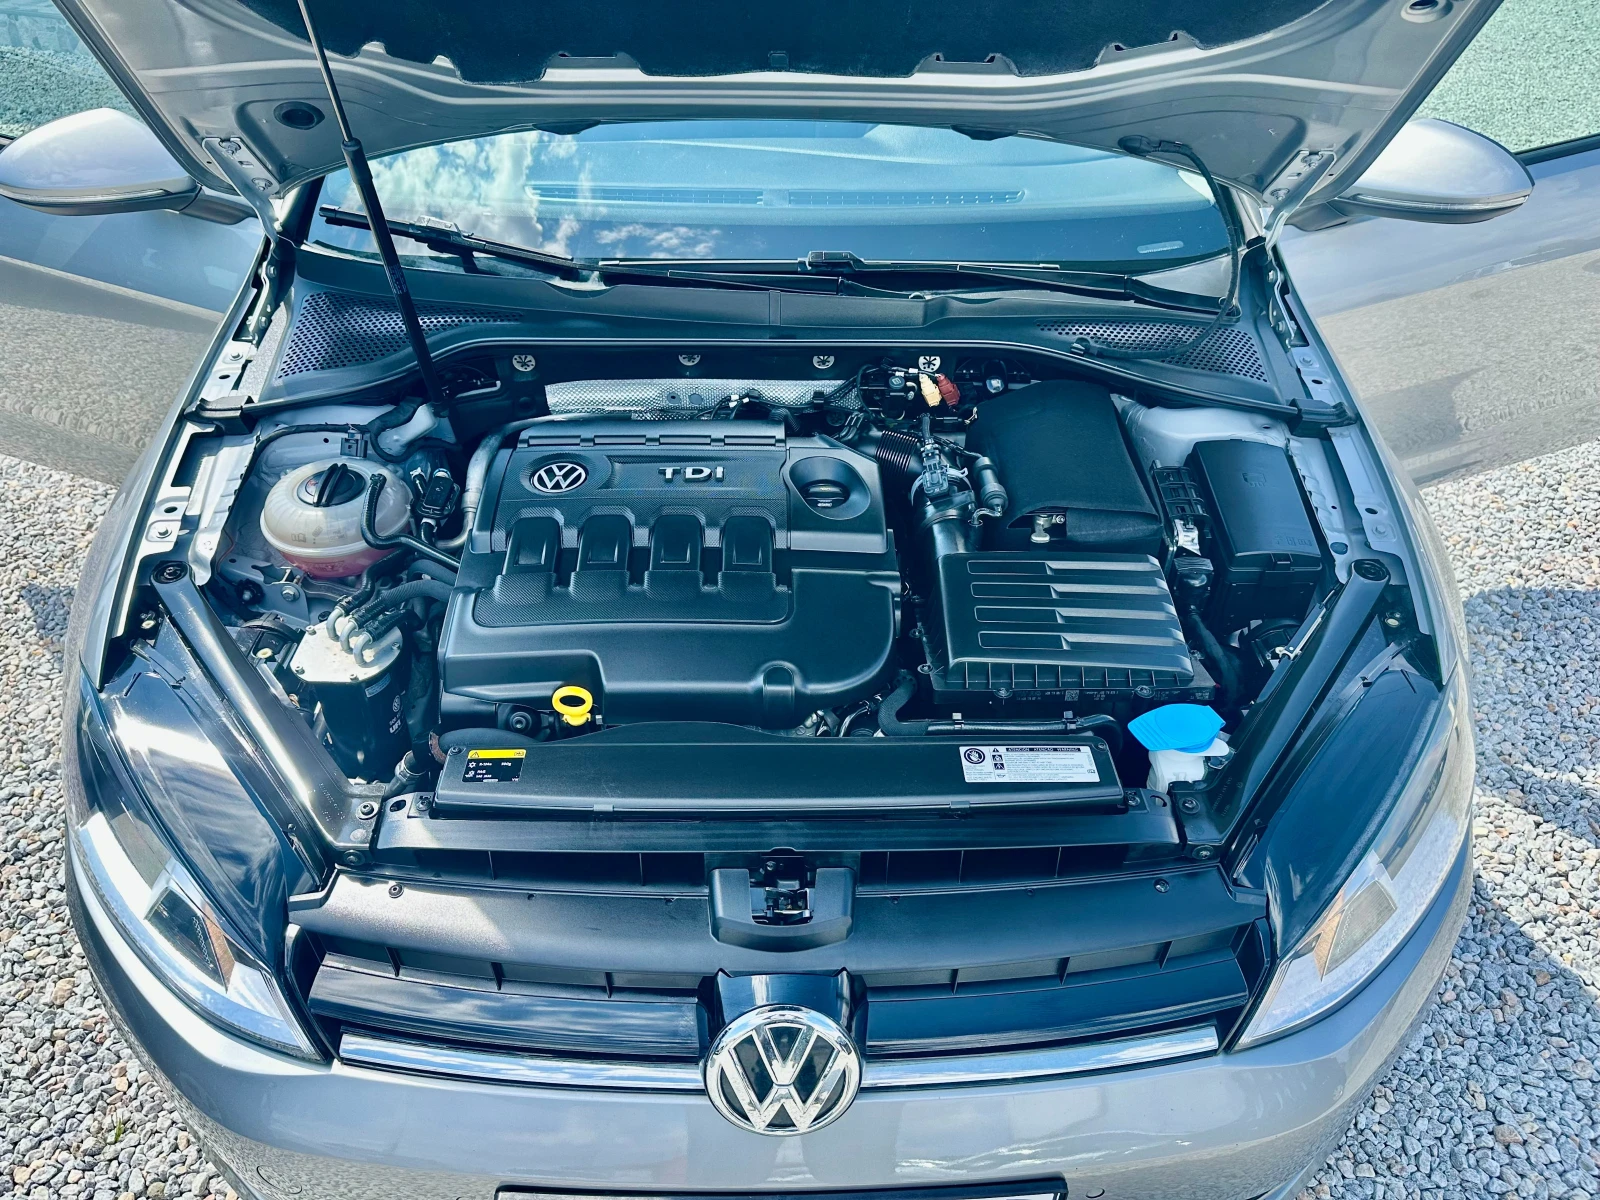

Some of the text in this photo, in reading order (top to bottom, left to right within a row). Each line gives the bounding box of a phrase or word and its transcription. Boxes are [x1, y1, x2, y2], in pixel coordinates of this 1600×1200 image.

[533, 462, 587, 493] VW
[658, 466, 726, 483] TDI
[706, 1004, 861, 1136] VW
